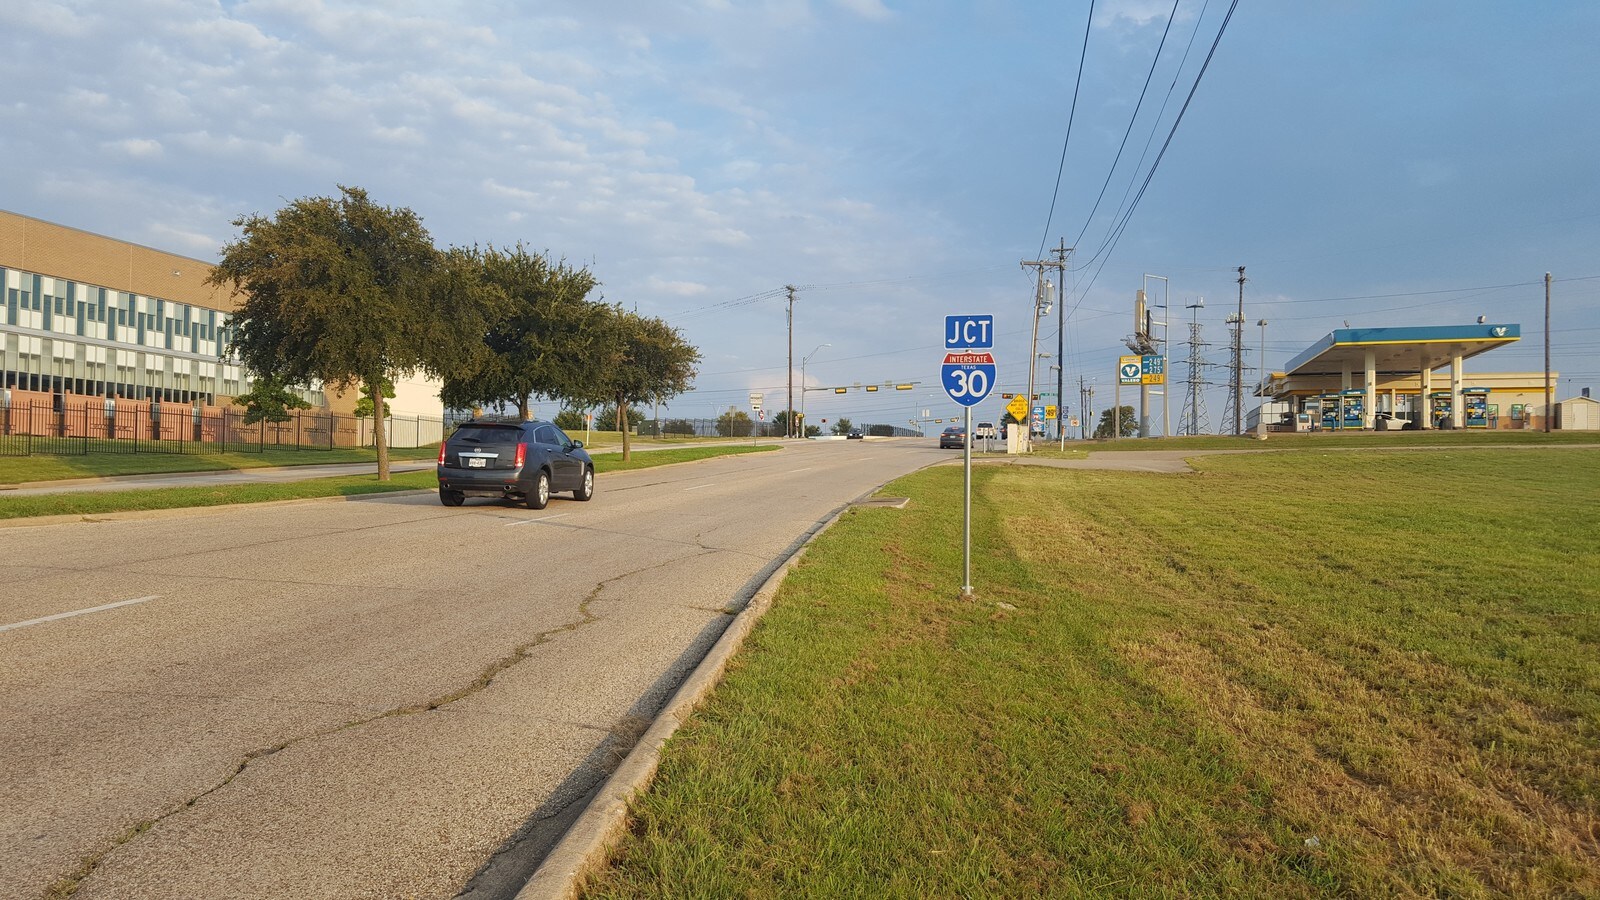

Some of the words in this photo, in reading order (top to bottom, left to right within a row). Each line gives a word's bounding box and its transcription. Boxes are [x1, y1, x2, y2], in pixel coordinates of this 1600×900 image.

[948, 320, 990, 344] JCT
[949, 355, 988, 363] INTERSTATE
[949, 370, 988, 397] 30
